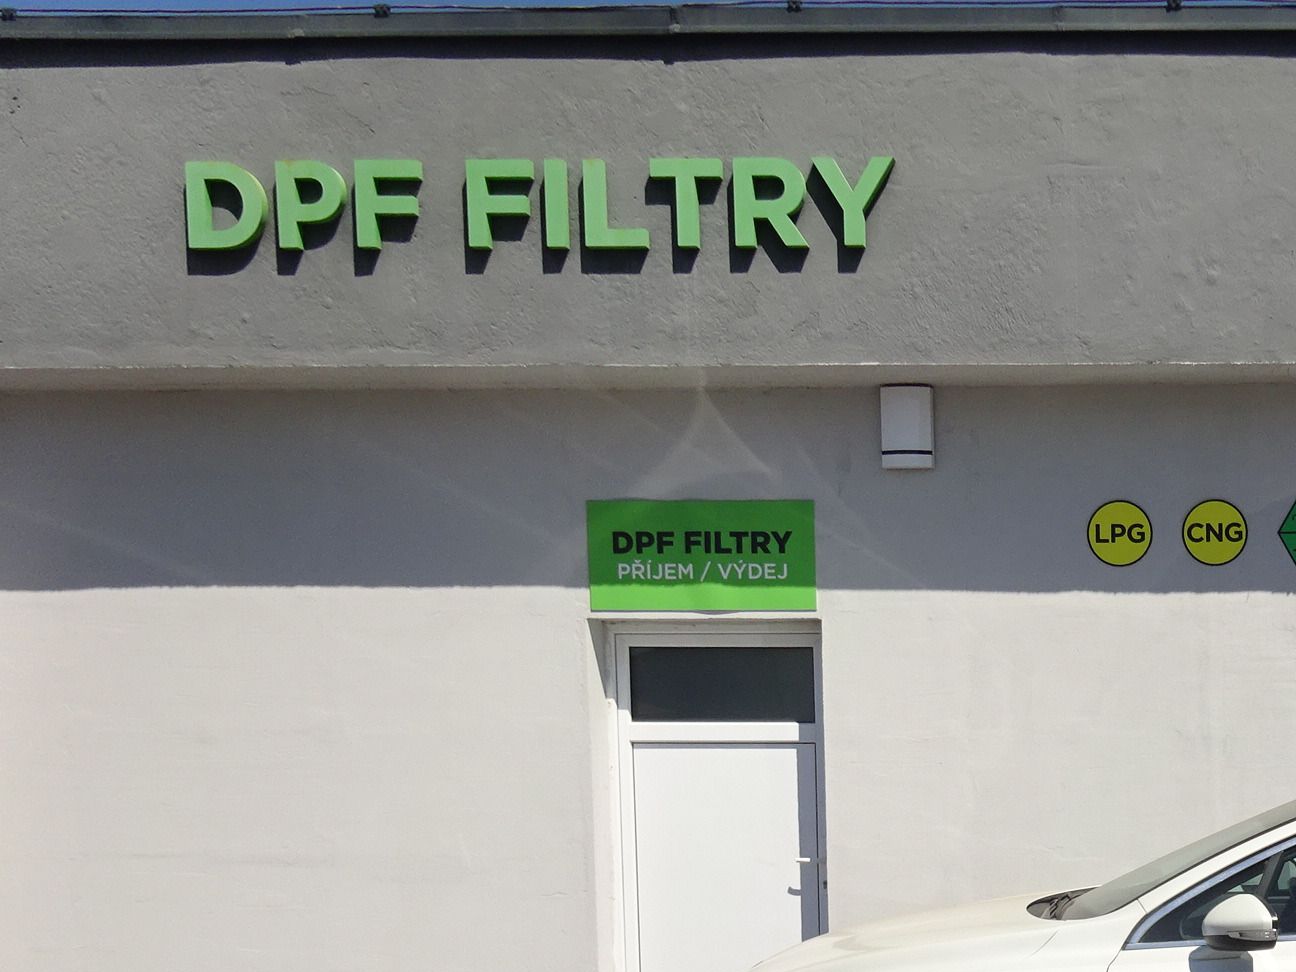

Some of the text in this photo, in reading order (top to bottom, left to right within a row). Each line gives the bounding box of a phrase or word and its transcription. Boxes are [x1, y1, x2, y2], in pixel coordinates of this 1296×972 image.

[184, 156, 896, 251] DPF FILTRY
[612, 531, 793, 554] DPF FILTRY
[1095, 523, 1146, 544] LPG
[1187, 522, 1243, 543] CNG
[618, 559, 788, 582] PŘÍJEM / VÝDEJ
